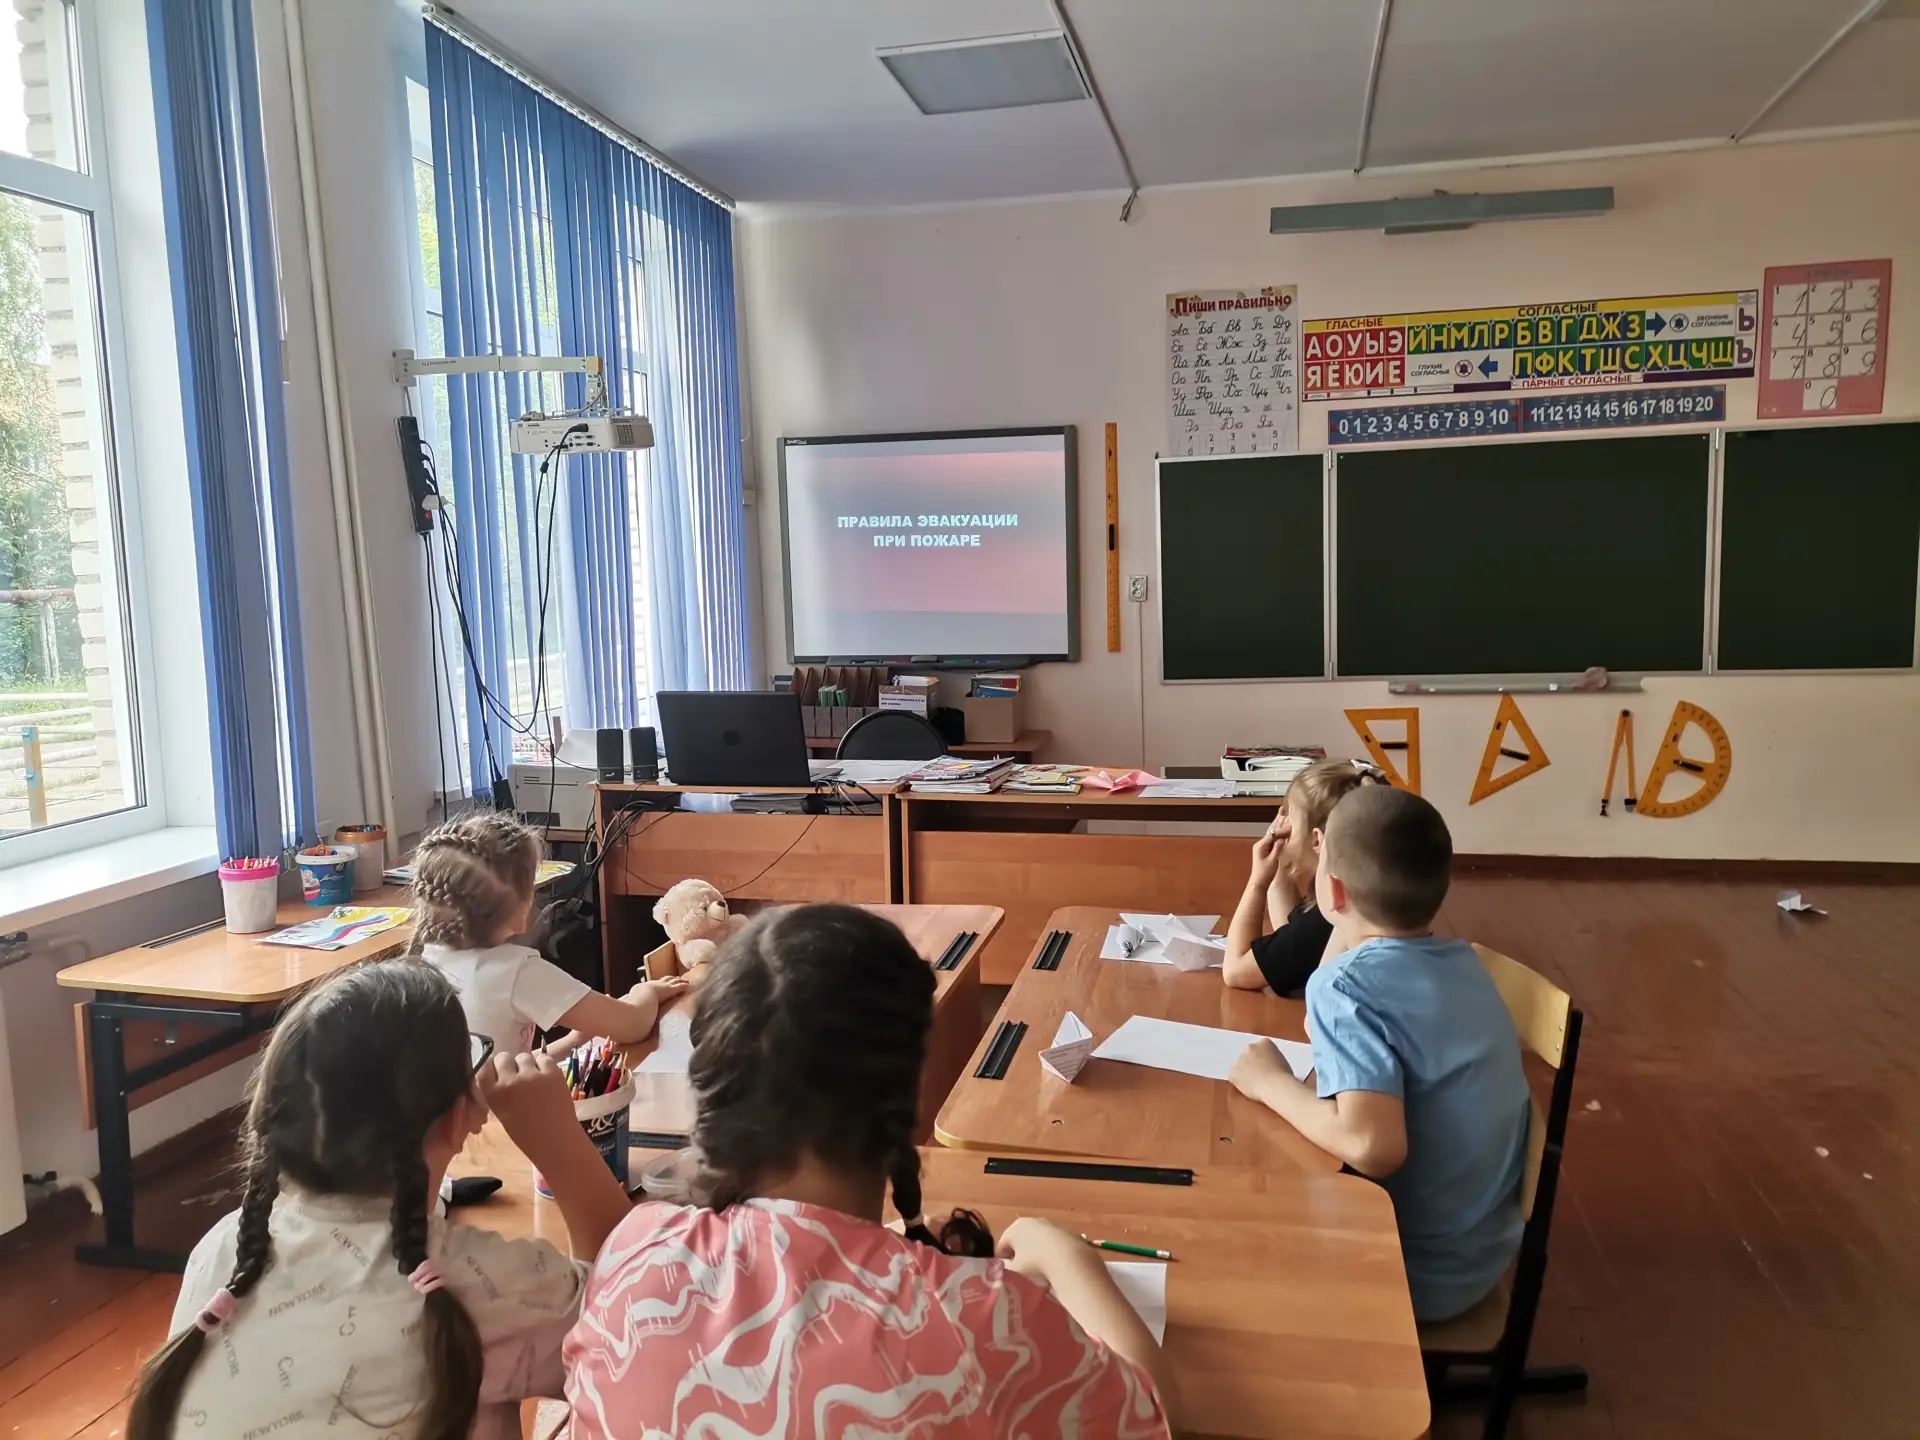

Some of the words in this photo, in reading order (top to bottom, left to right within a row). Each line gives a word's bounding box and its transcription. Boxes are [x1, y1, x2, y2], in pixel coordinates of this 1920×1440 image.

[1518, 303, 1598, 318] СОГЛАСНЫЕ
[1794, 290, 1808, 314] 1
[1828, 288, 1845, 313] 2
[1864, 285, 1880, 310] 3
[1326, 317, 1384, 330] ГЛАСНЫЕ
[1792, 322, 1806, 348] 4
[1826, 320, 1843, 346] 5
[1861, 318, 1878, 343] 6
[1790, 355, 1804, 378] 7
[1823, 354, 1840, 378] 8
[1860, 351, 1876, 376] 9
[1522, 378, 1566, 388] ПАРНЫЕ
[1568, 374, 1632, 386] СОГЛАСНЫЕ
[1531, 407, 1546, 422] 11
[1548, 406, 1564, 420] 12
[1566, 404, 1582, 420] 13
[1584, 403, 1600, 418] 14
[1604, 402, 1620, 418] 15
[1622, 401, 1638, 416] 16
[1640, 400, 1656, 415] 17
[1660, 398, 1674, 414] 18
[1677, 398, 1692, 412] 19
[1695, 396, 1714, 412] 20
[1820, 386, 1838, 410] 0
[1339, 419, 1348, 434] 0
[1354, 418, 1361, 433] 1
[1368, 416, 1378, 432] 2
[1383, 416, 1393, 432] 3
[1398, 415, 1408, 431] 4
[1414, 414, 1423, 430] 5
[1429, 413, 1438, 428] 6
[1444, 412, 1454, 428] 7
[1458, 411, 1468, 426] 8
[1474, 410, 1484, 426] 9
[1490, 408, 1508, 424] 10
[838, 516, 912, 528] ПРАВИЛА
[917, 514, 1018, 528] ЭВАКУАЦИИ
[874, 535, 906, 547] ПРИ
[910, 534, 980, 547] ПОЖАРЕ
